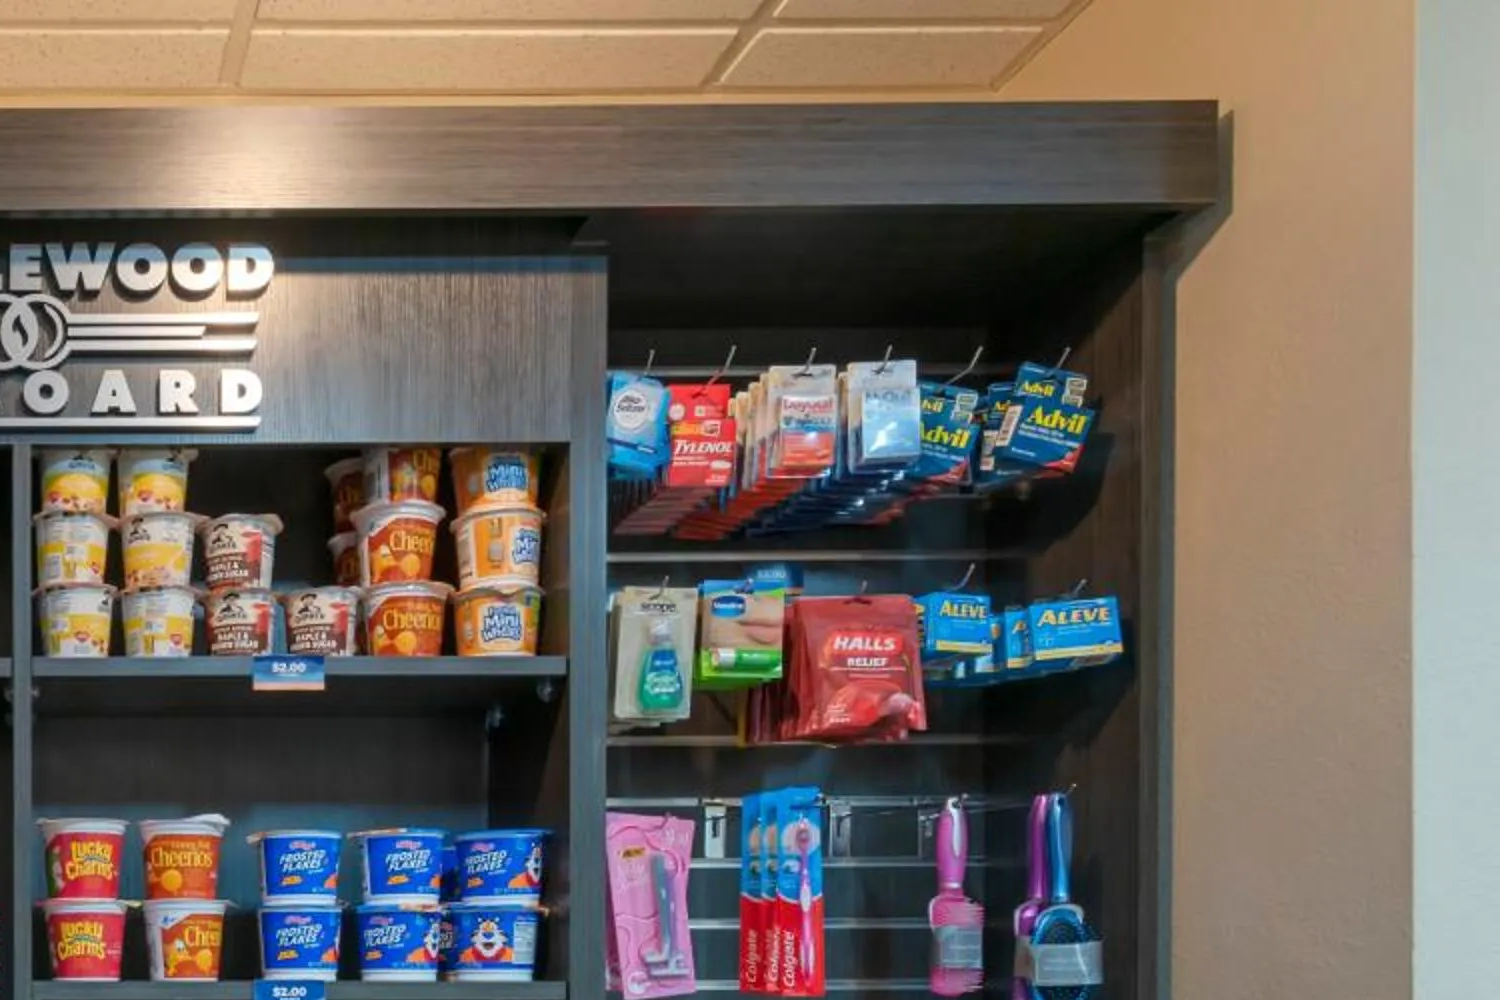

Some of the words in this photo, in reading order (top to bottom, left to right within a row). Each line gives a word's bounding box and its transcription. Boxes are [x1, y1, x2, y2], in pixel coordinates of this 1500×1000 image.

[1027, 404, 1088, 435] Advil
[673, 440, 733, 455] TYLENOL
[939, 600, 988, 620] ALEVE
[1036, 606, 1111, 627] ALEVE
[833, 636, 897, 652] HALLS
[271, 661, 307, 674] $2.00
[846, 657, 889, 668] RELIEF
[151, 848, 213, 869] Cheerios
[782, 930, 796, 988] Colgate
[272, 986, 307, 998] $2.00
